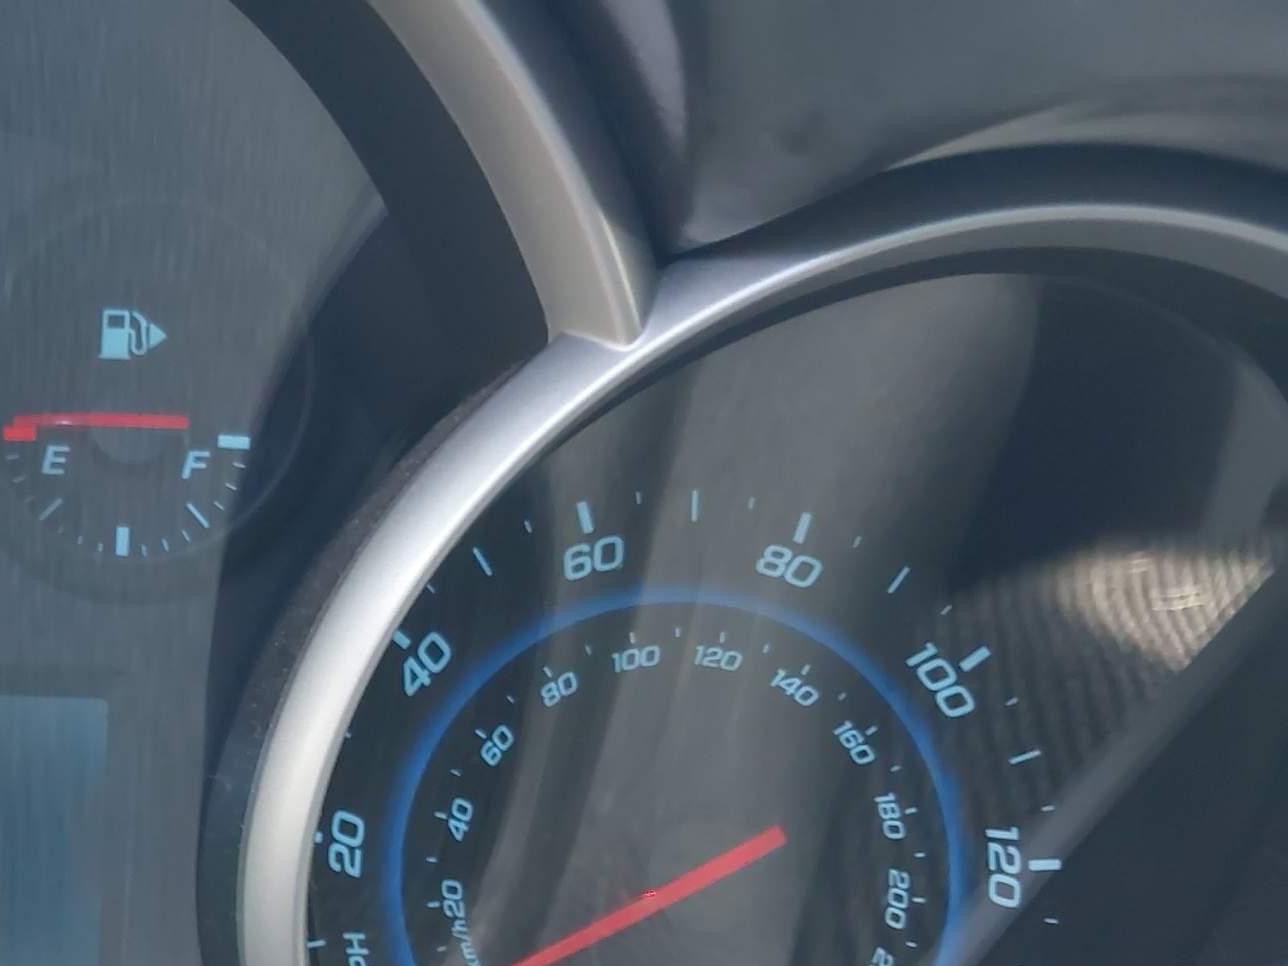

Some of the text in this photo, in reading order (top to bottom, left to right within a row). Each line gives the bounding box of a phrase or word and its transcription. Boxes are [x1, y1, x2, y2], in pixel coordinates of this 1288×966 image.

[42, 445, 70, 475] E
[182, 450, 211, 480] F
[563, 533, 624, 581] 60
[756, 543, 822, 588] 80
[401, 631, 452, 696] 40
[612, 645, 661, 673] 100
[695, 645, 743, 671] 120
[907, 642, 974, 718] 100
[540, 671, 578, 707] 80
[770, 667, 819, 706] 140
[480, 726, 514, 766] 60
[834, 721, 875, 765] 160
[447, 797, 474, 841] 40
[874, 792, 905, 840] 180
[328, 810, 365, 878] 20
[985, 827, 1022, 908] 120
[441, 879, 465, 918] 20
[885, 869, 910, 929] 200
